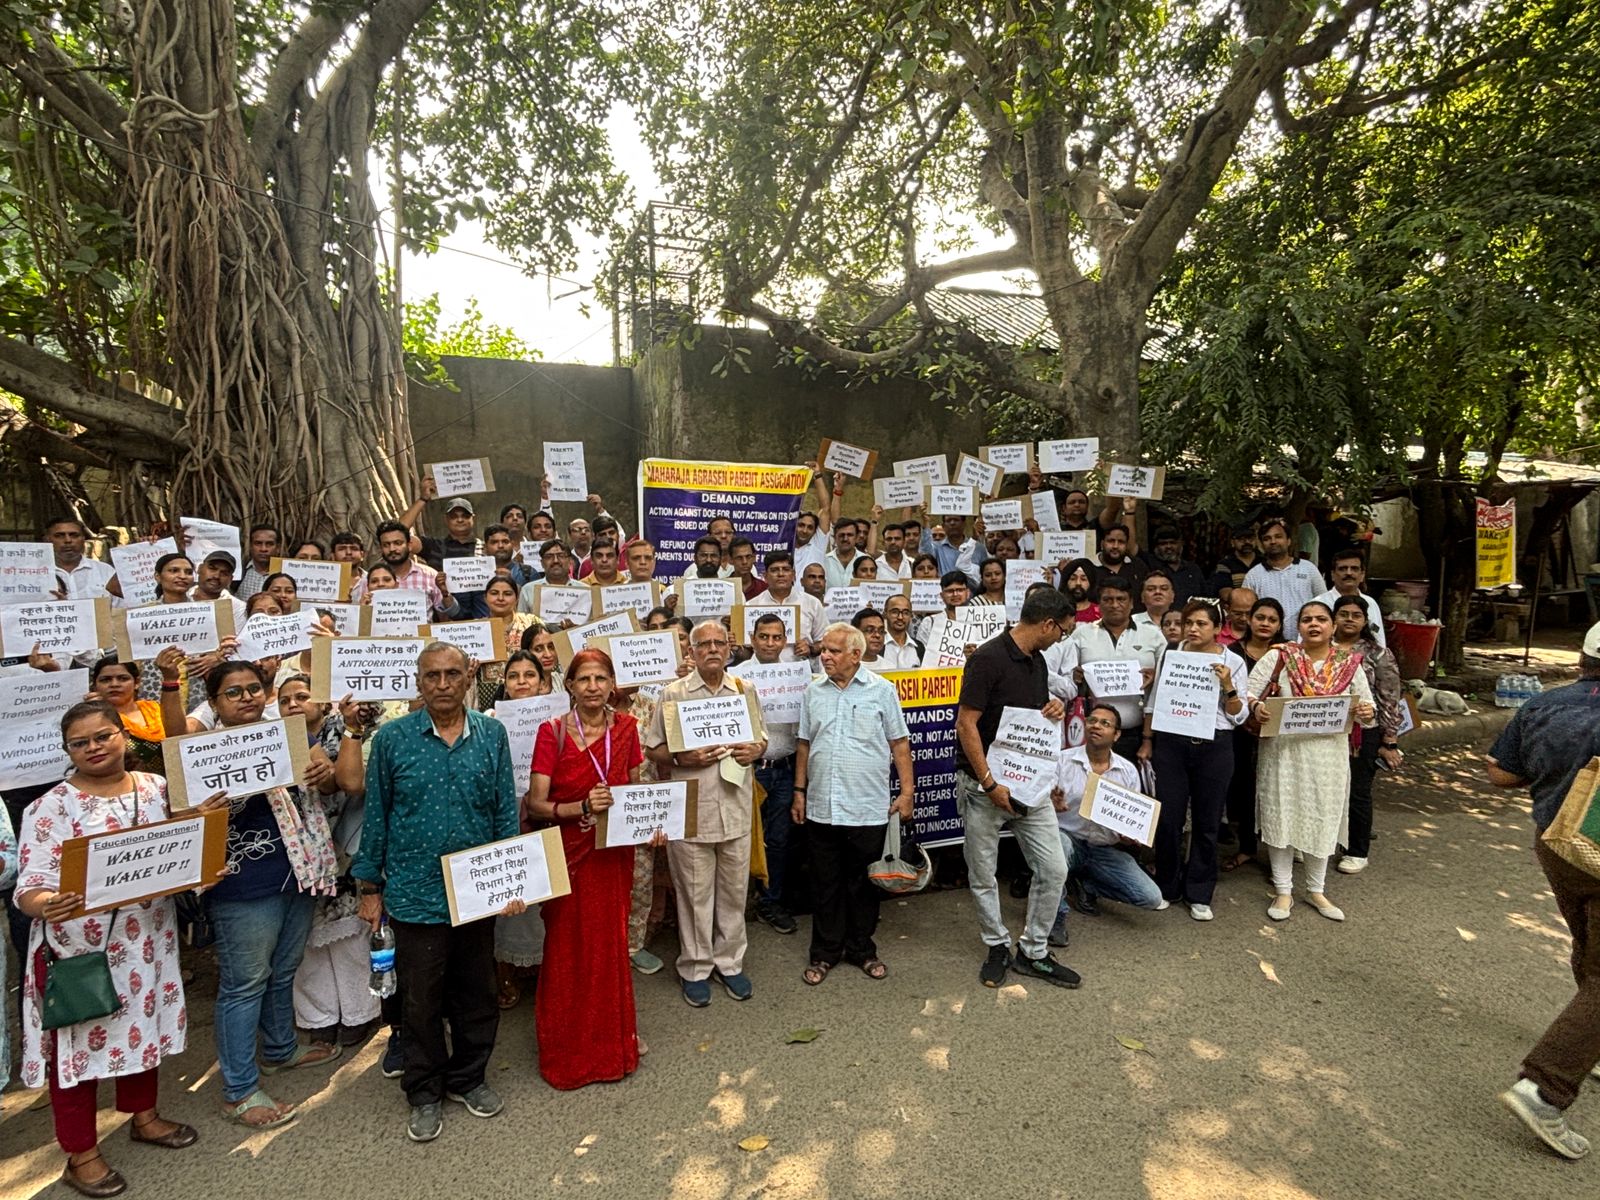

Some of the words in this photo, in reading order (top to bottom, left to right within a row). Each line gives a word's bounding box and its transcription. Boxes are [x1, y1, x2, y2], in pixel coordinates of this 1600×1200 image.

[849, 459, 860, 468] The
[648, 466, 690, 484] MAHARAJA
[692, 471, 728, 486] AGRASEN
[730, 472, 758, 488] PARENT
[760, 473, 807, 490] ASSOCIATION
[702, 493, 756, 505] DEMANDS
[649, 507, 673, 516] ACTION
[674, 508, 702, 518] AGAINST
[702, 508, 716, 518] DOE
[716, 510, 730, 518] FOR
[732, 511, 746, 519] NOT
[746, 512, 768, 520] ACTING
[778, 512, 788, 520] ITS
[674, 520, 698, 530] ISSUED
[760, 525, 779, 533] YEARS
[6, 548, 26, 558] कभी
[28, 550, 44, 558] नहीं
[20, 606, 42, 616] स्कूल
[45, 604, 54, 612] के
[56, 604, 74, 612] साथ
[965, 608, 997, 623] Make
[19, 616, 52, 626] मिलकर
[54, 614, 78, 624] शिक्षा
[140, 619, 176, 630] WAKE
[180, 618, 195, 626] UP
[197, 616, 206, 626] !!
[23, 628, 52, 638] विभाग
[54, 626, 61, 634] ने
[63, 626, 76, 634] की
[944, 619, 973, 642] Roll
[144, 634, 179, 646] WAKE
[182, 632, 198, 642] UP
[200, 632, 208, 640] !!
[619, 639, 647, 648] Reform
[650, 637, 663, 645] The
[337, 648, 362, 656] Zone
[385, 645, 404, 654] PSB
[406, 644, 419, 654] की
[629, 647, 657, 656] System
[338, 659, 419, 668] ANTICORRUPTION
[622, 659, 650, 668] Revive
[652, 656, 668, 665] The
[632, 669, 662, 678] Future
[1169, 672, 1212, 684] Knowledge,
[346, 670, 384, 691] जाँच
[390, 670, 411, 692] हो
[922, 675, 958, 699] PARENT
[1178, 680, 1190, 689] for
[1192, 682, 1214, 692] Profit
[758, 686, 775, 697] स्कूलों
[776, 684, 786, 693] की
[1104, 684, 1128, 694] हेराफेरी
[14, 693, 61, 706] Demand
[732, 698, 743, 708] की
[1170, 698, 1188, 710] Stop
[1189, 702, 1202, 710] the
[1, 704, 72, 720] Transparency
[686, 710, 746, 724] ANTICORRUPTION
[693, 720, 722, 740] जाँच
[727, 718, 742, 737] हो
[1284, 720, 1310, 729] सुनवाई
[1312, 718, 1327, 728] क्यों
[1328, 718, 1342, 728] नहीं
[18, 735, 34, 744] No
[37, 731, 62, 740] Hike
[186, 743, 218, 755] Zone
[242, 732, 264, 744] PSB
[266, 726, 280, 738] की
[1006, 734, 1052, 748] Knowledge,
[2, 747, 46, 760] Without
[191, 740, 284, 770] ANTICORRUPTION
[917, 748, 934, 760] FOR
[934, 746, 954, 759] LAST
[202, 764, 250, 790] जाँच
[255, 756, 276, 784] हो
[1002, 758, 1022, 770] Stop
[1024, 764, 1038, 774] the
[918, 775, 932, 788] FEE
[1002, 769, 1032, 782] LOOT"
[626, 789, 645, 800] स्कूल
[647, 786, 655, 797] के
[657, 787, 672, 796] साथ
[920, 794, 925, 802] 5
[926, 789, 952, 802] YEARS
[624, 802, 652, 814] मिलकर
[653, 800, 672, 811] शिक्षा
[912, 806, 940, 819] CRORE
[1104, 794, 1128, 810] WAKE
[1128, 805, 1141, 816] UP
[1140, 810, 1148, 818] !!
[626, 814, 650, 826] विभाग
[650, 812, 657, 822] ने
[658, 810, 668, 822] की
[1100, 806, 1126, 822] WAKE
[1126, 816, 1138, 828] UP
[1138, 822, 1145, 831] !!
[916, 823, 926, 834] TO
[926, 818, 964, 832] INNOCENT
[93, 833, 146, 852] Education
[147, 822, 200, 843] Department
[106, 845, 156, 868] WAKE
[158, 840, 180, 857] UP
[180, 838, 193, 852] !!
[469, 853, 492, 866] स्कूल
[494, 848, 504, 860] के
[505, 844, 524, 856] साथ
[104, 866, 152, 888] WAKE
[156, 860, 178, 876] UP
[178, 858, 191, 871] !!
[470, 863, 503, 881] मिलकर
[504, 856, 529, 873] शिक्षा
[476, 878, 504, 893] विभाग
[504, 873, 513, 886] ने
[514, 870, 528, 882] की
[487, 884, 525, 907] हेराफेरी
